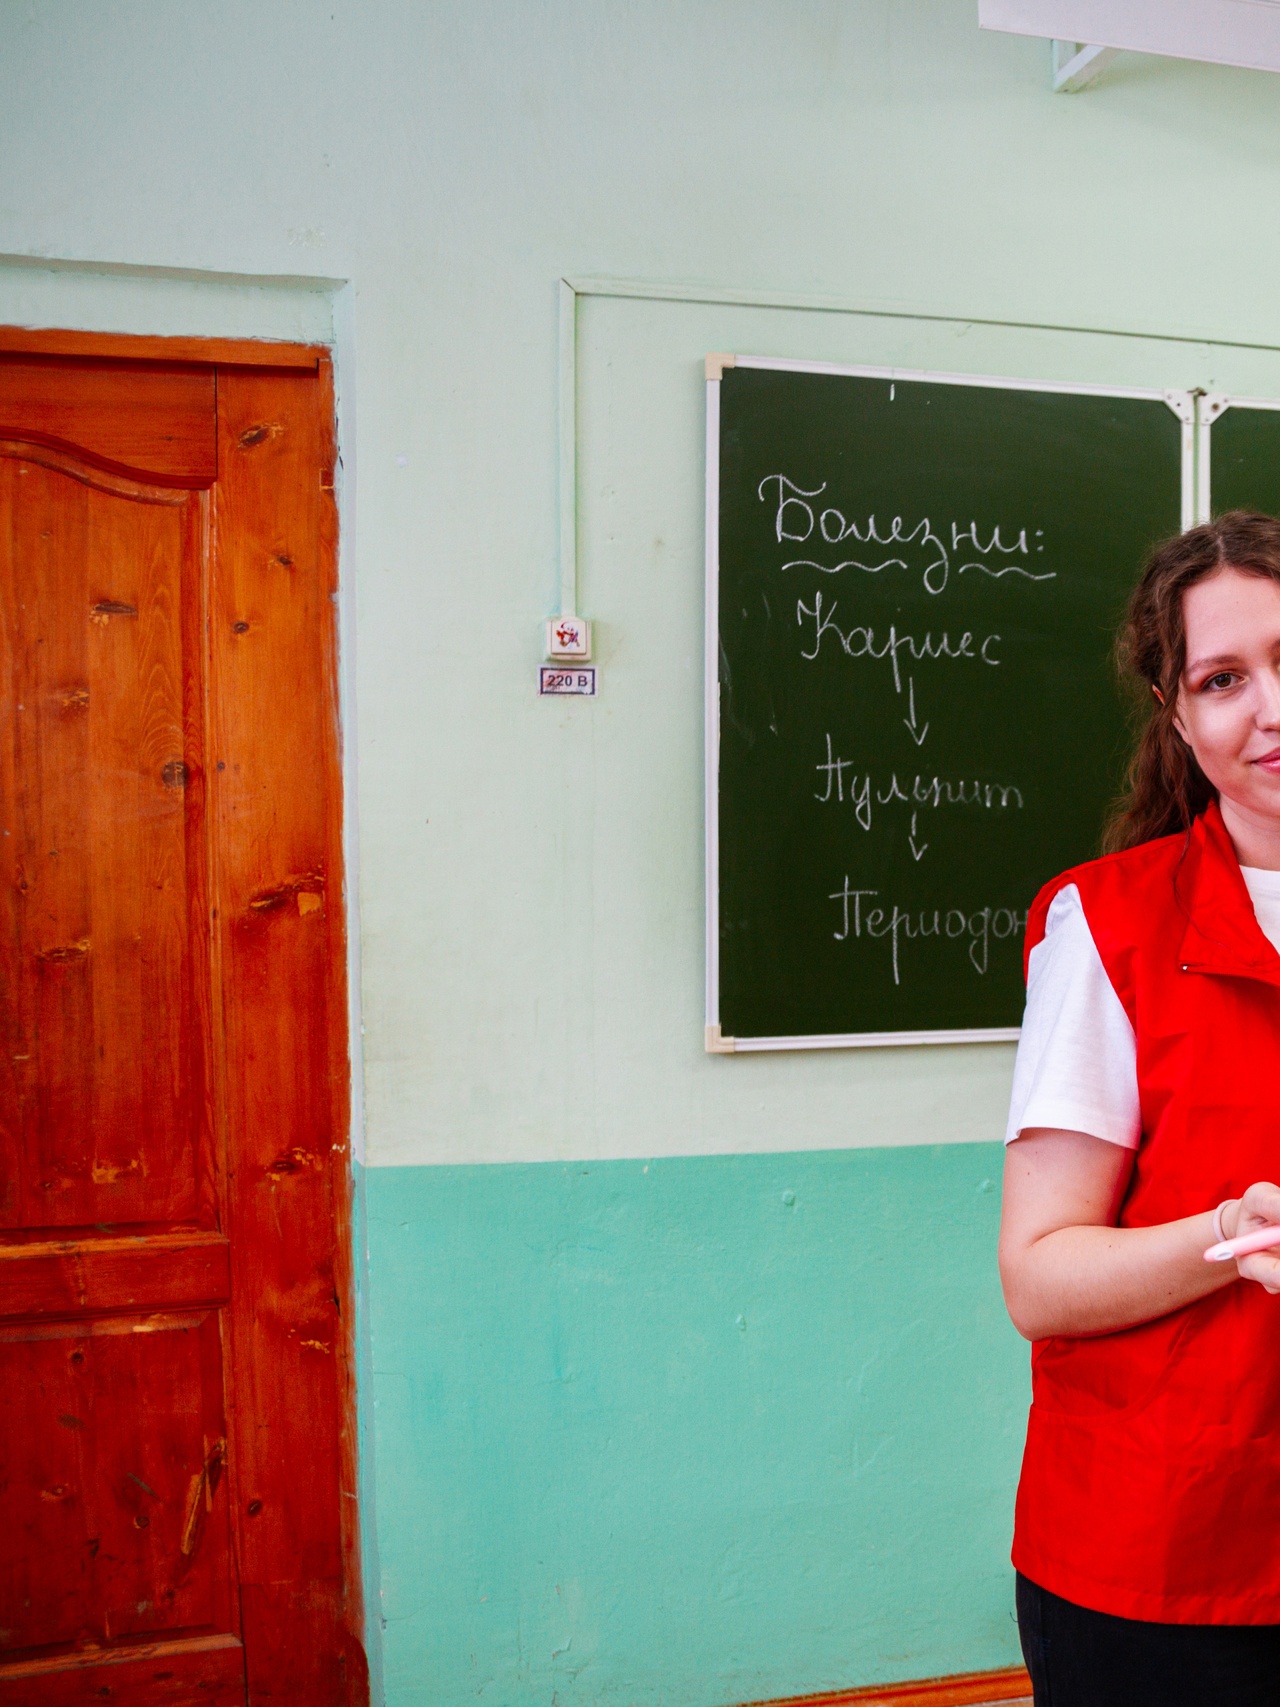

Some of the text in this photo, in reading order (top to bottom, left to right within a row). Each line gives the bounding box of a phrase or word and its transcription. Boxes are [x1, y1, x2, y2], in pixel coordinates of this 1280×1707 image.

[758, 474, 1044, 594] Болезни:
[548, 675, 588, 687] 220 В
[796, 590, 1001, 693] Кариес
[814, 732, 1024, 831] Пульпит
[828, 875, 1029, 985] Периодон
